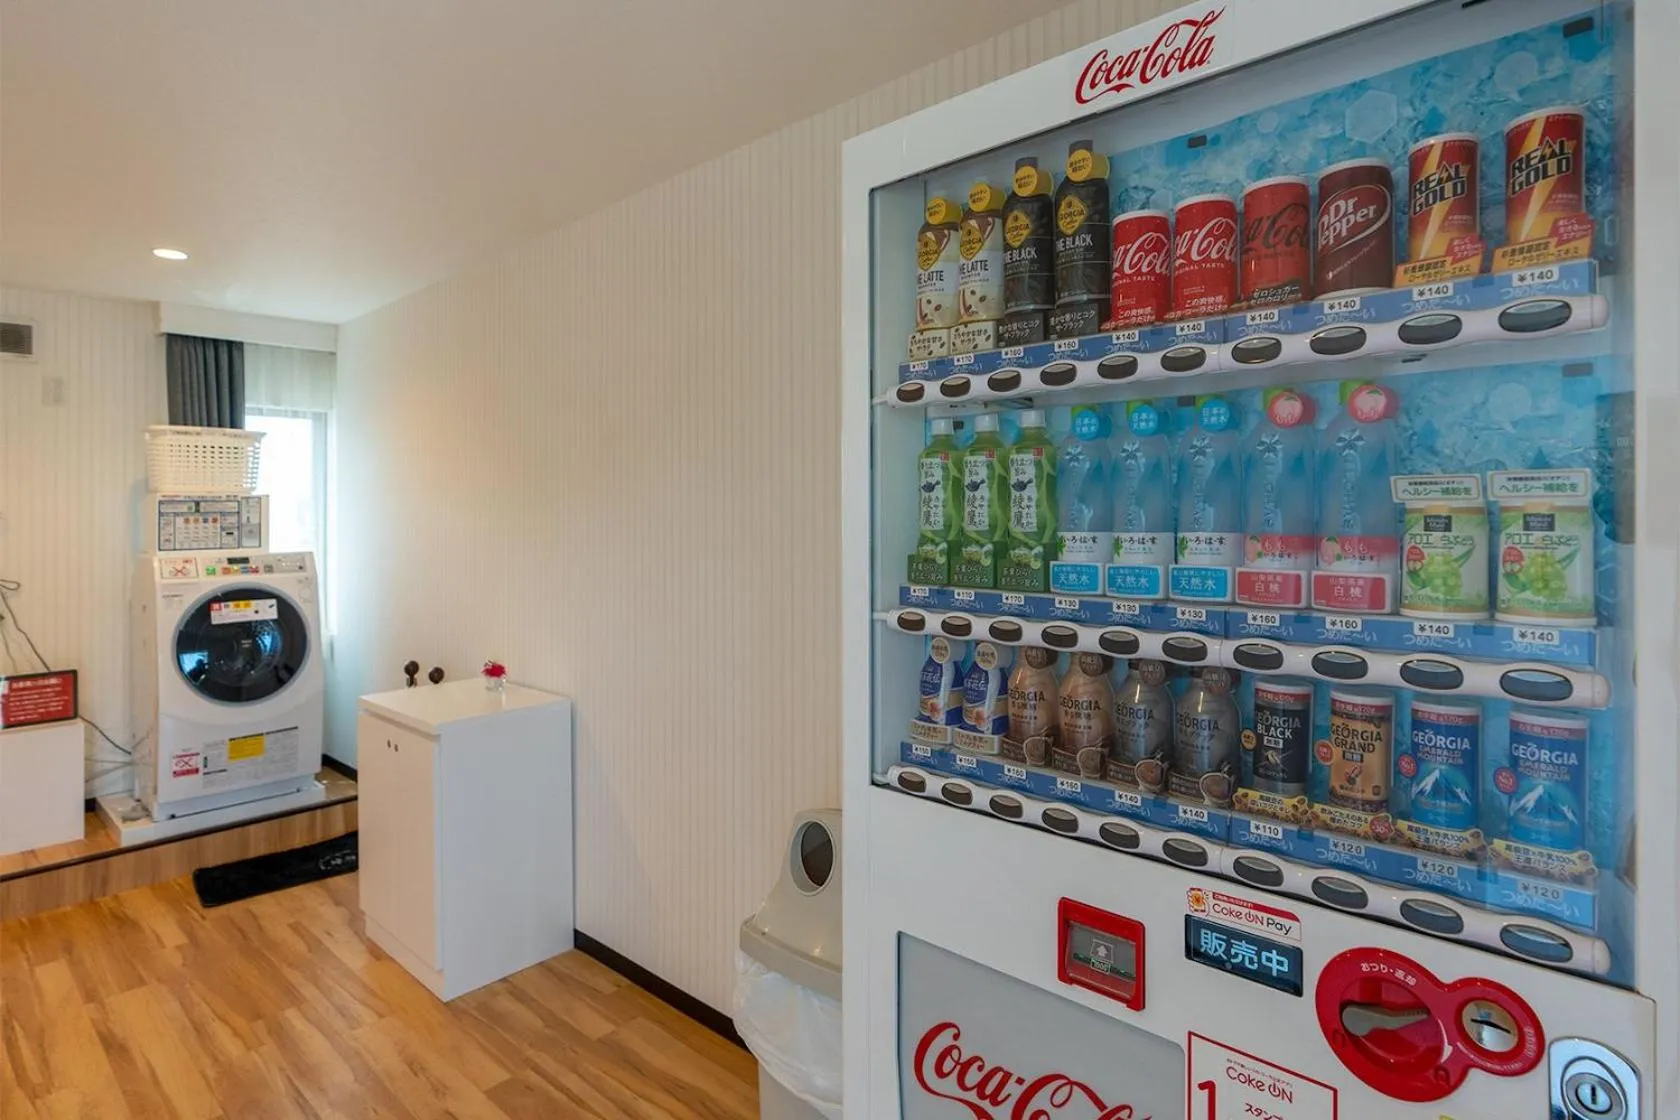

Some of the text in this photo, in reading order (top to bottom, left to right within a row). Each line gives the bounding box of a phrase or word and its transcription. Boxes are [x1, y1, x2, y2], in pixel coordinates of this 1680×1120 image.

[1075, 4, 1226, 104] Coca-Cola
[1511, 137, 1572, 179] REAL
[1413, 162, 1468, 196] REAL
[1510, 156, 1572, 197] GOLD
[1412, 178, 1467, 216] GOLD
[1328, 197, 1357, 224] Dr
[1066, 234, 1093, 248] BLACK
[1013, 247, 1037, 260] BLACK
[969, 260, 990, 271] LATTE
[924, 270, 944, 281] LATTE
[1517, 269, 1554, 283] ¥140
[1418, 285, 1449, 297] ¥140
[1328, 300, 1356, 311] ¥140
[1250, 312, 1275, 322] ¥140
[1179, 322, 1202, 332] ¥140
[1116, 332, 1136, 341] ¥140
[1402, 487, 1472, 496] ヘルシー補給を
[1500, 483, 1578, 494] ヘルシー補給を
[1059, 573, 1090, 586] 天然水
[1115, 575, 1150, 588] 天然水
[1178, 577, 1217, 591] 天然水
[1255, 582, 1281, 594] 白桃
[1333, 585, 1363, 598] 白桃
[1115, 602, 1137, 612] ¥130
[1180, 608, 1204, 618] ¥130
[1252, 614, 1276, 624] ¥160
[1330, 618, 1358, 629] ¥160
[1418, 624, 1449, 635] ¥140
[1518, 630, 1555, 643] ¥140
[1257, 724, 1293, 739] BLACK
[1334, 734, 1376, 753] GRAND
[1412, 729, 1471, 750] GEORGIA
[1512, 741, 1579, 766] GEORGIA
[1118, 793, 1139, 803] ¥140
[1182, 808, 1205, 819] ¥140
[1254, 823, 1279, 836] ¥110
[1333, 841, 1362, 855] ¥120
[1421, 861, 1455, 876] ¥120
[1521, 882, 1560, 899] ¥120
[1212, 903, 1292, 936] Coke ON Pay
[1200, 928, 1289, 977] 販売中
[1226, 1065, 1265, 1092] Coke
[1268, 1082, 1294, 1104] ON
